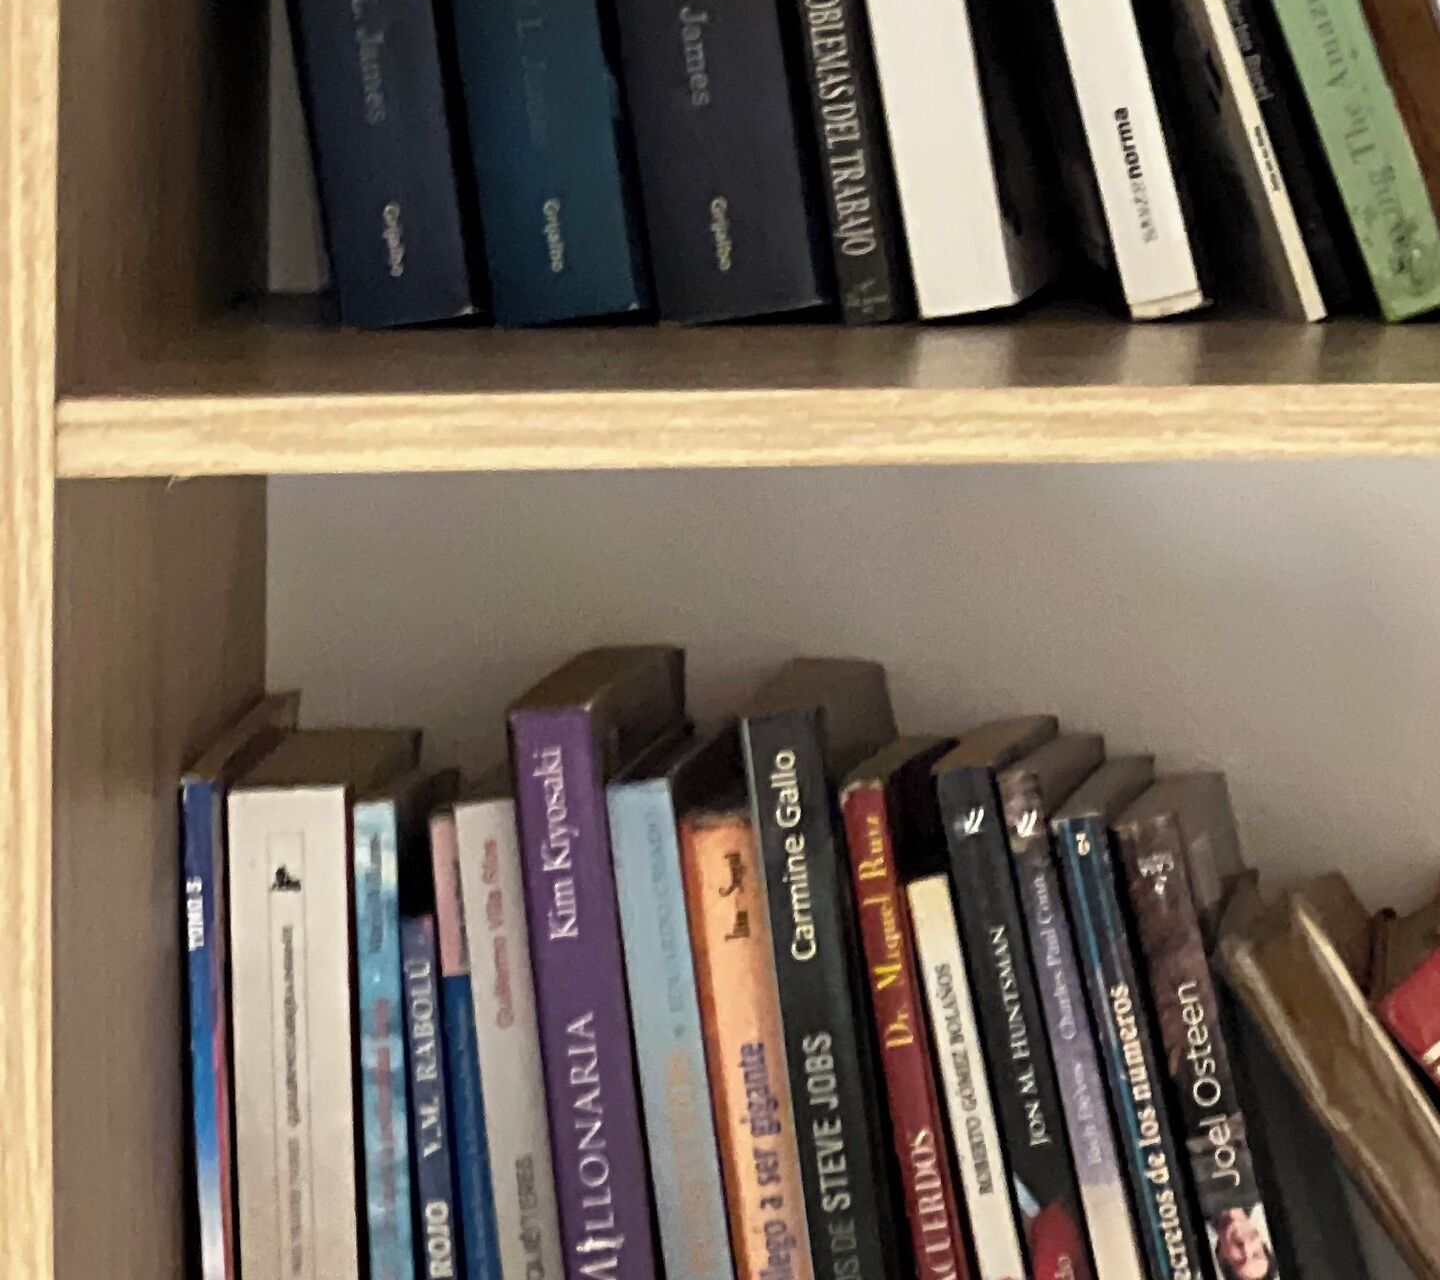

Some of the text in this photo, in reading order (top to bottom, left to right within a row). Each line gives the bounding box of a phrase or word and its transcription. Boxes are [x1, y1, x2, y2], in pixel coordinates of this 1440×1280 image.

[355, 28, 394, 125] James
[679, 6, 719, 106] James
[821, 101, 861, 150] DEL
[1107, 107, 1143, 180] norma
[1333, 106, 1376, 165] The
[829, 148, 877, 256] TRABAJO
[532, 746, 579, 940] Kim Kiyosaki
[770, 750, 817, 961] Carmine Gallo
[852, 816, 887, 881] Ruiz
[862, 894, 905, 990] Miguel
[1040, 928, 1062, 967] Paul
[989, 925, 1030, 1060] HUNTSMAN
[730, 1040, 783, 1138] gigante
[801, 1033, 839, 1110] JOBS
[1167, 980, 1241, 1186] Joel Osteen
[965, 1117, 993, 1195] ROBERTO
[1025, 1100, 1051, 1146] JON
[1130, 1106, 1161, 1148] los
[753, 1148, 782, 1187] ser
[759, 1195, 784, 1210] a
[812, 1118, 851, 1212] STEVE
[1143, 1152, 1170, 1184] de
[424, 1201, 453, 1278] ROJO
[828, 1219, 857, 1252] DE
